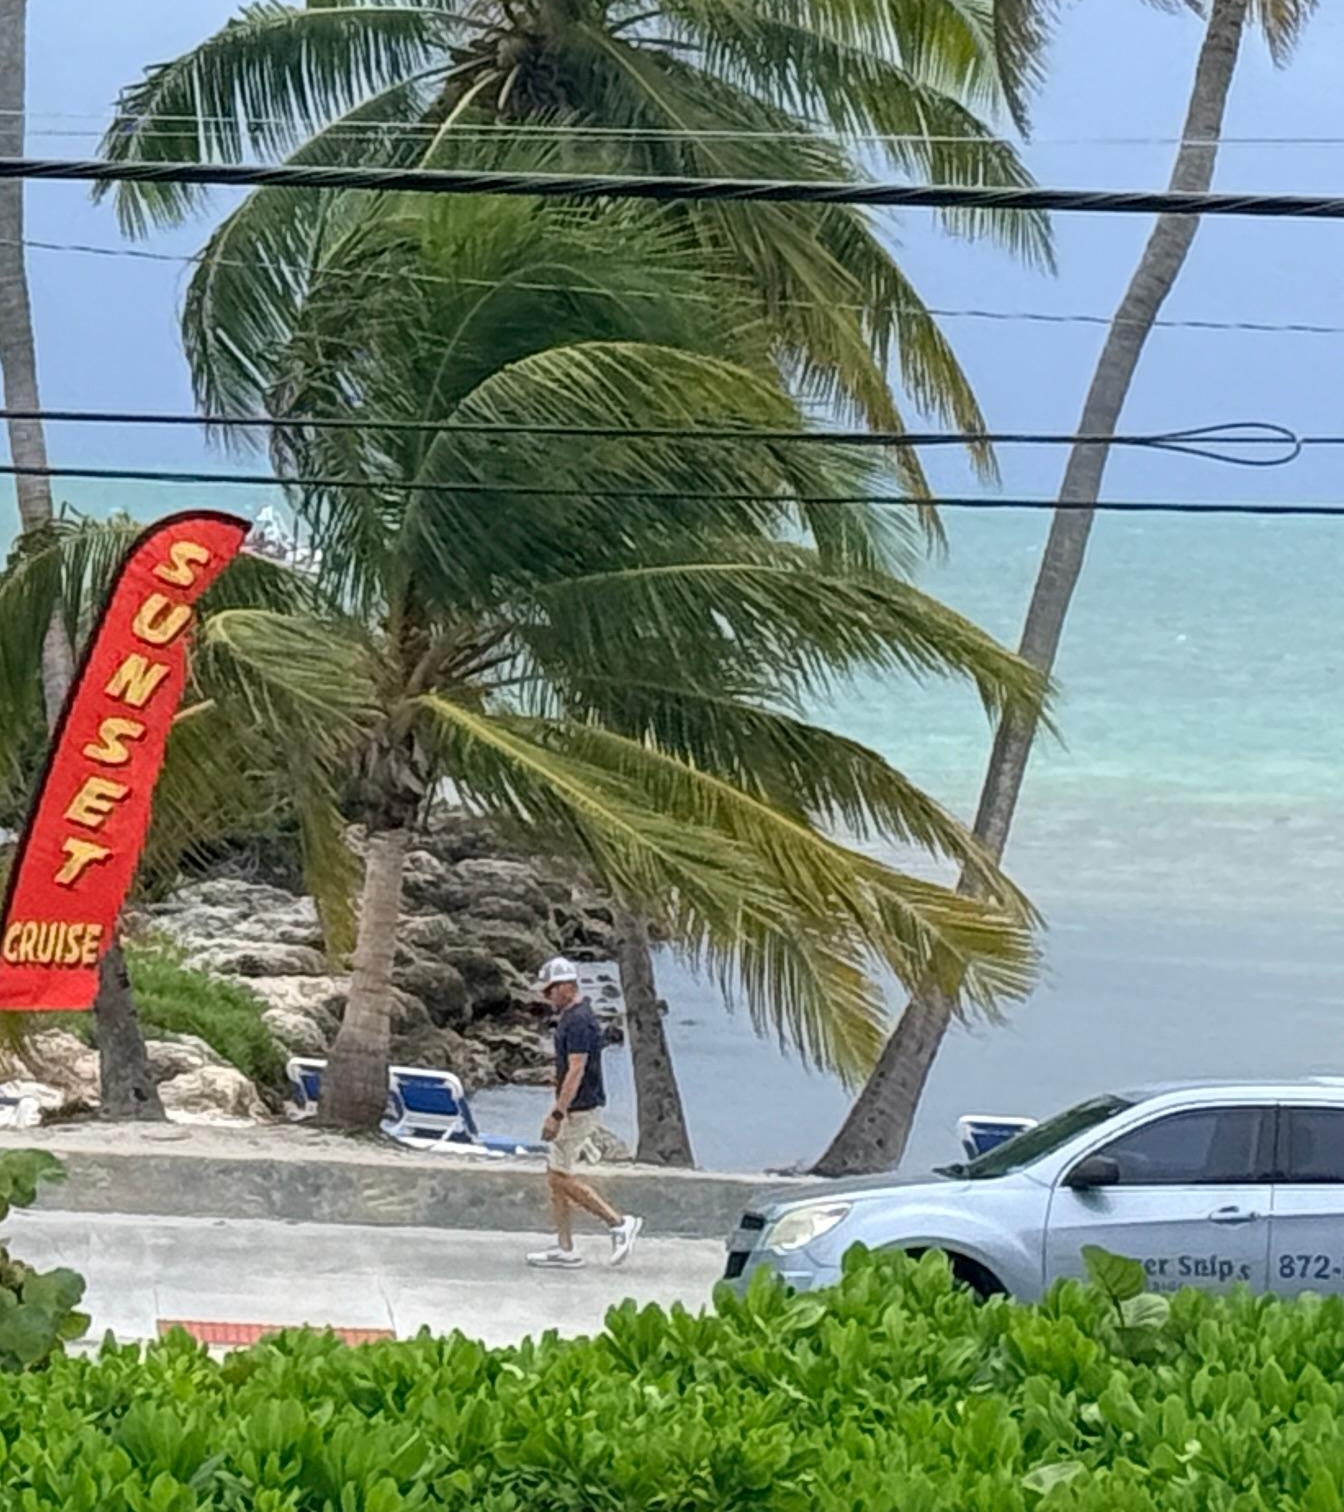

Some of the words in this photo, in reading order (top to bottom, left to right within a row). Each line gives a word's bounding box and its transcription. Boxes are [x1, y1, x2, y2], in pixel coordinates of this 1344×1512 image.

[53, 539, 211, 887] SUNSET
[3, 920, 105, 967] CRUISE
[1279, 1253, 1344, 1279] 872-
